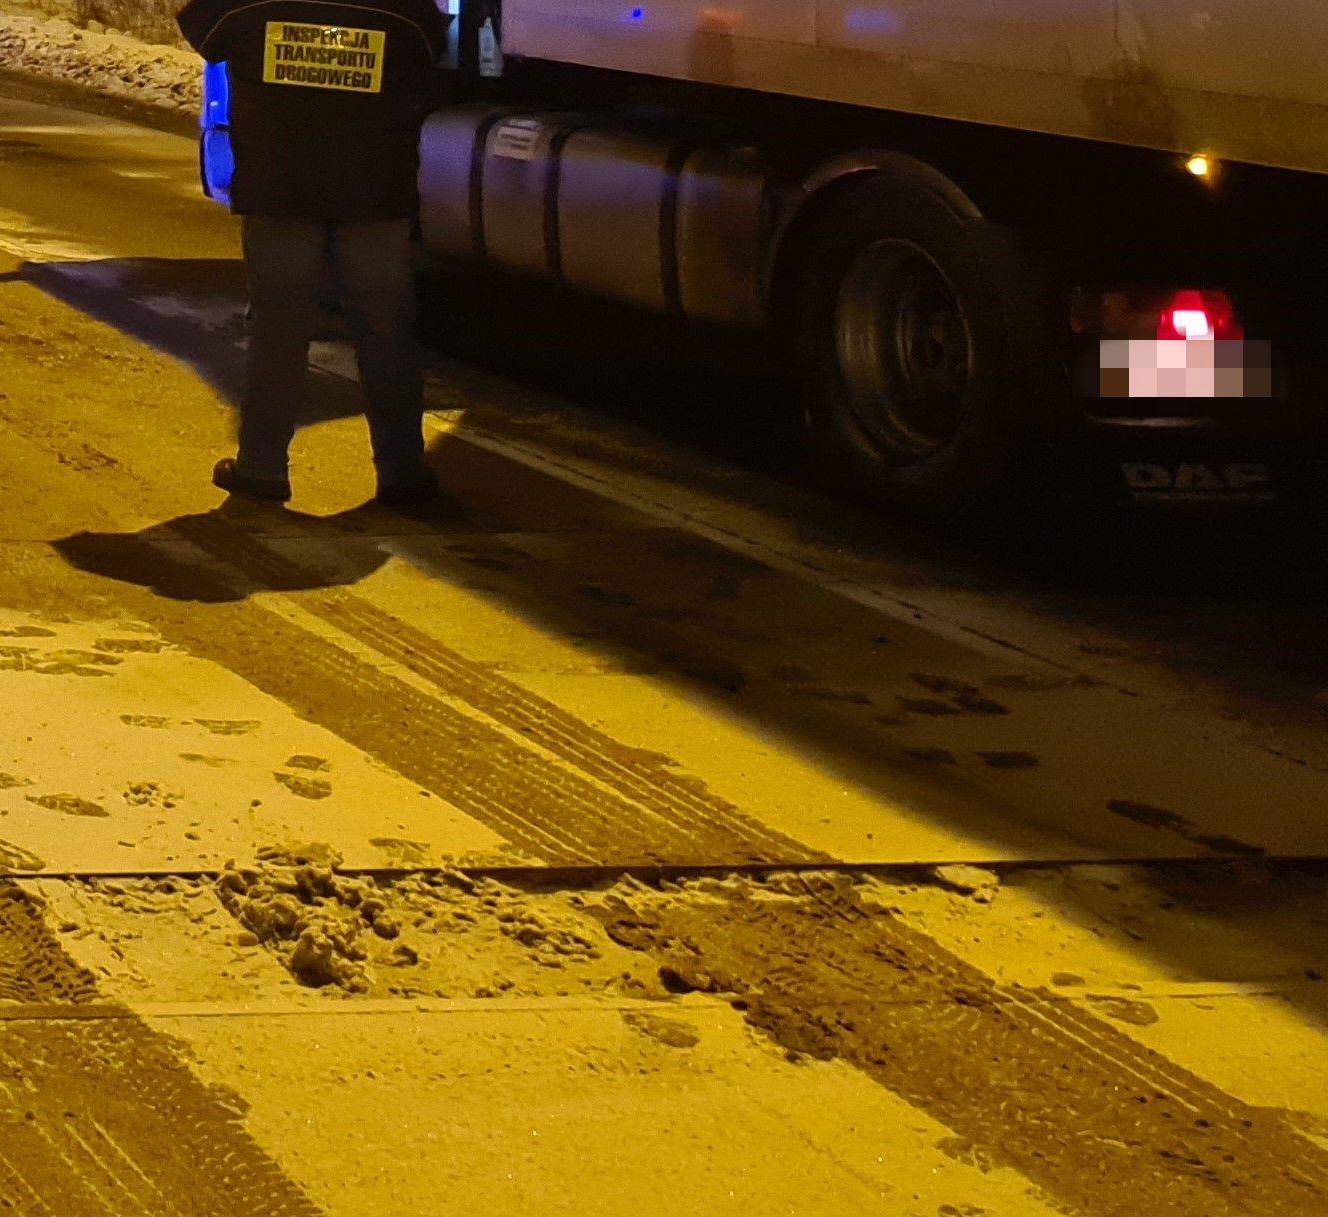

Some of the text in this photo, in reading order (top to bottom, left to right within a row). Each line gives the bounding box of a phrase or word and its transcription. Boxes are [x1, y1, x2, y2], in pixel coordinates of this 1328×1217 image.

[274, 44, 377, 69] TRANSPORTU
[275, 64, 372, 89] DROGOWEGO
[1121, 463, 1269, 490] DAF
